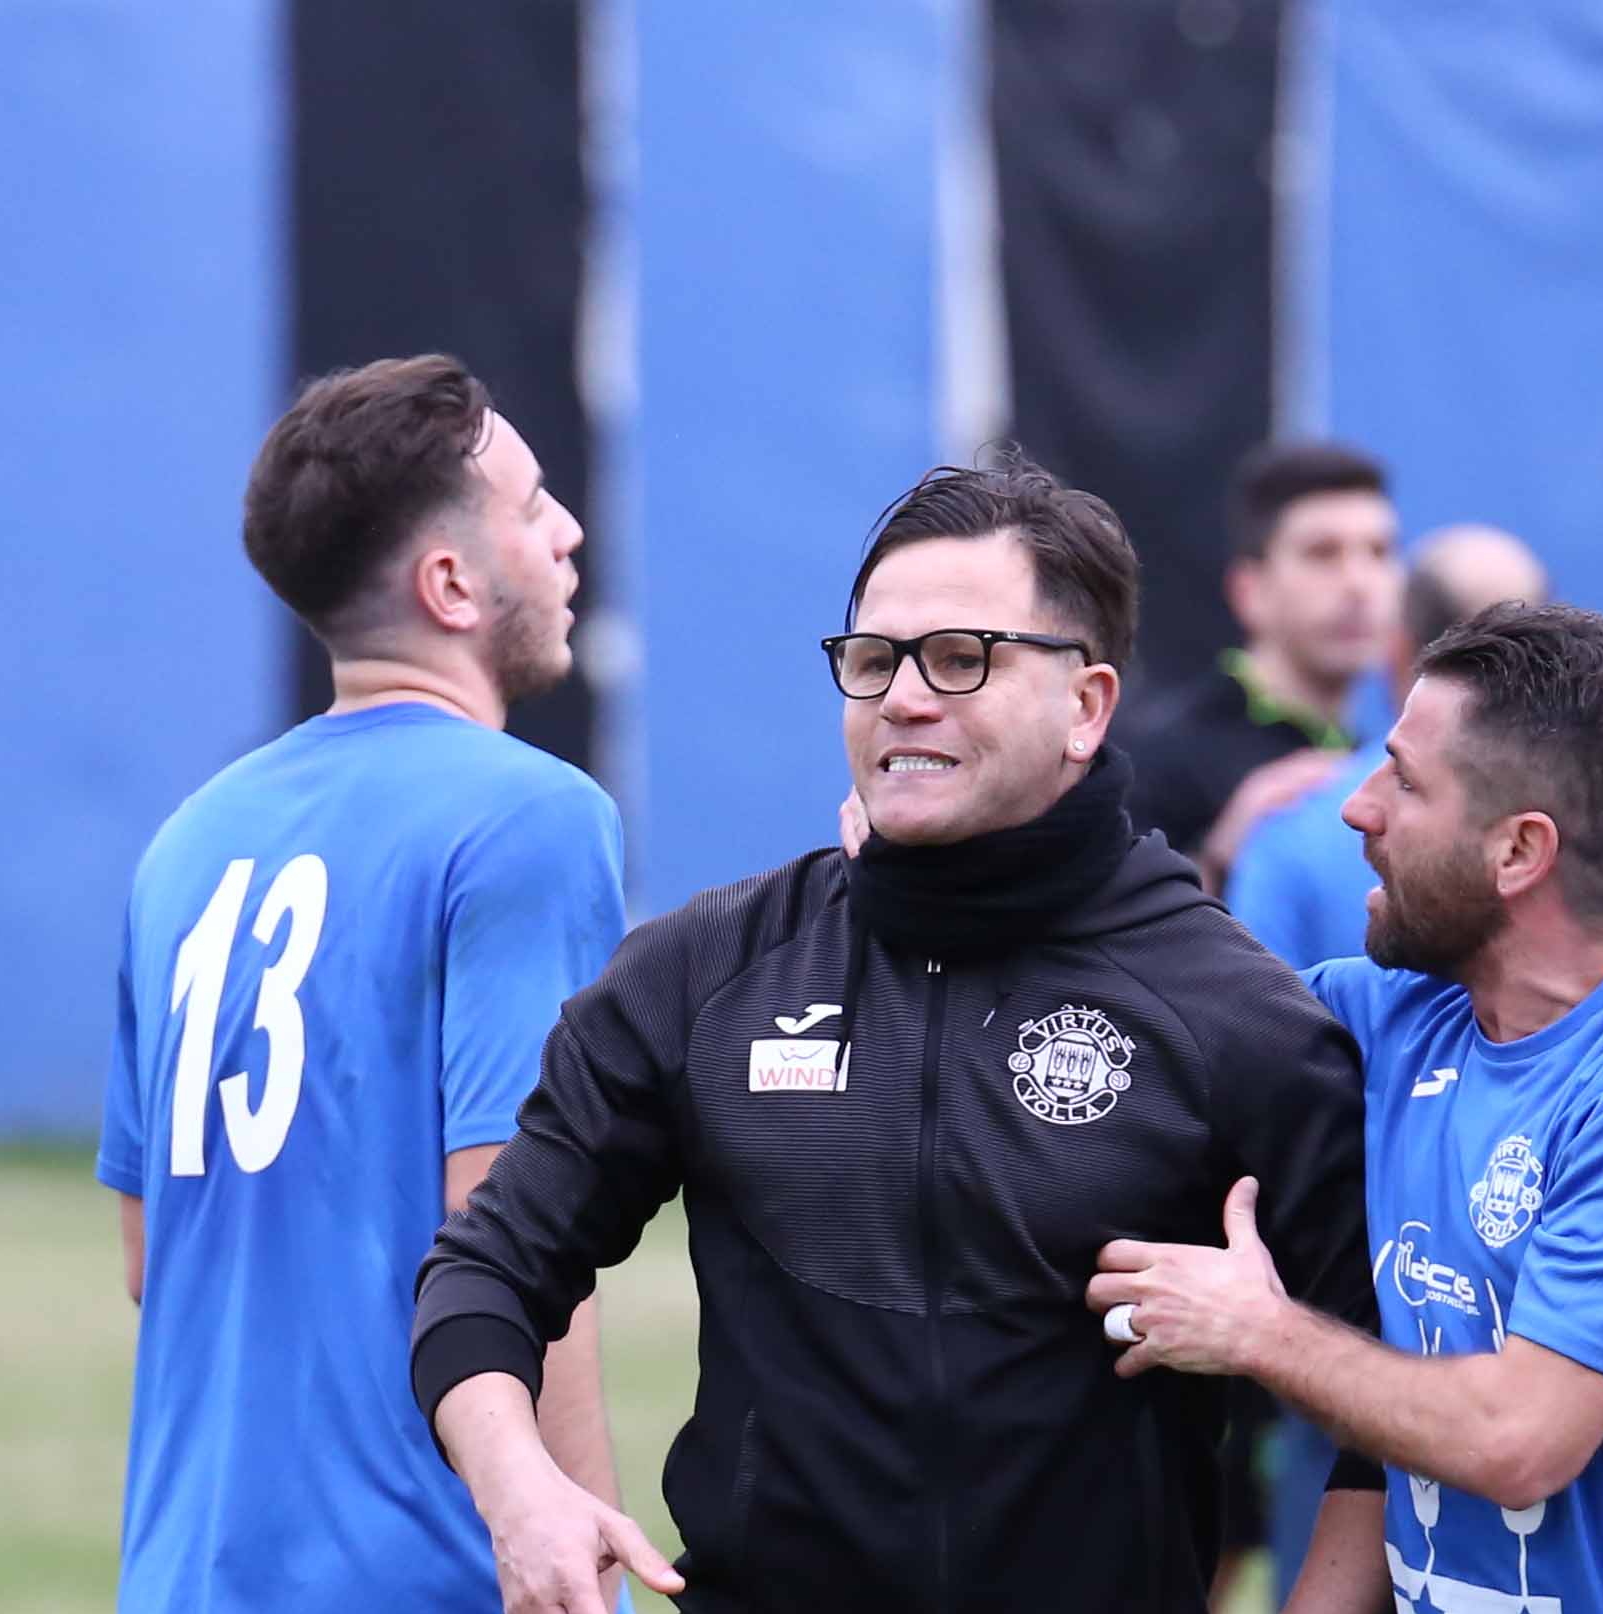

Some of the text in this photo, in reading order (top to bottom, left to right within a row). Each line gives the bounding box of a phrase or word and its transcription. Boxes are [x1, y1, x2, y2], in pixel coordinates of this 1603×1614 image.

[170, 853, 329, 1177] 13
[1032, 1013, 1121, 1053] VIRTUS
[757, 1066, 836, 1088] WIND
[1022, 1086, 1101, 1121] VOLLA
